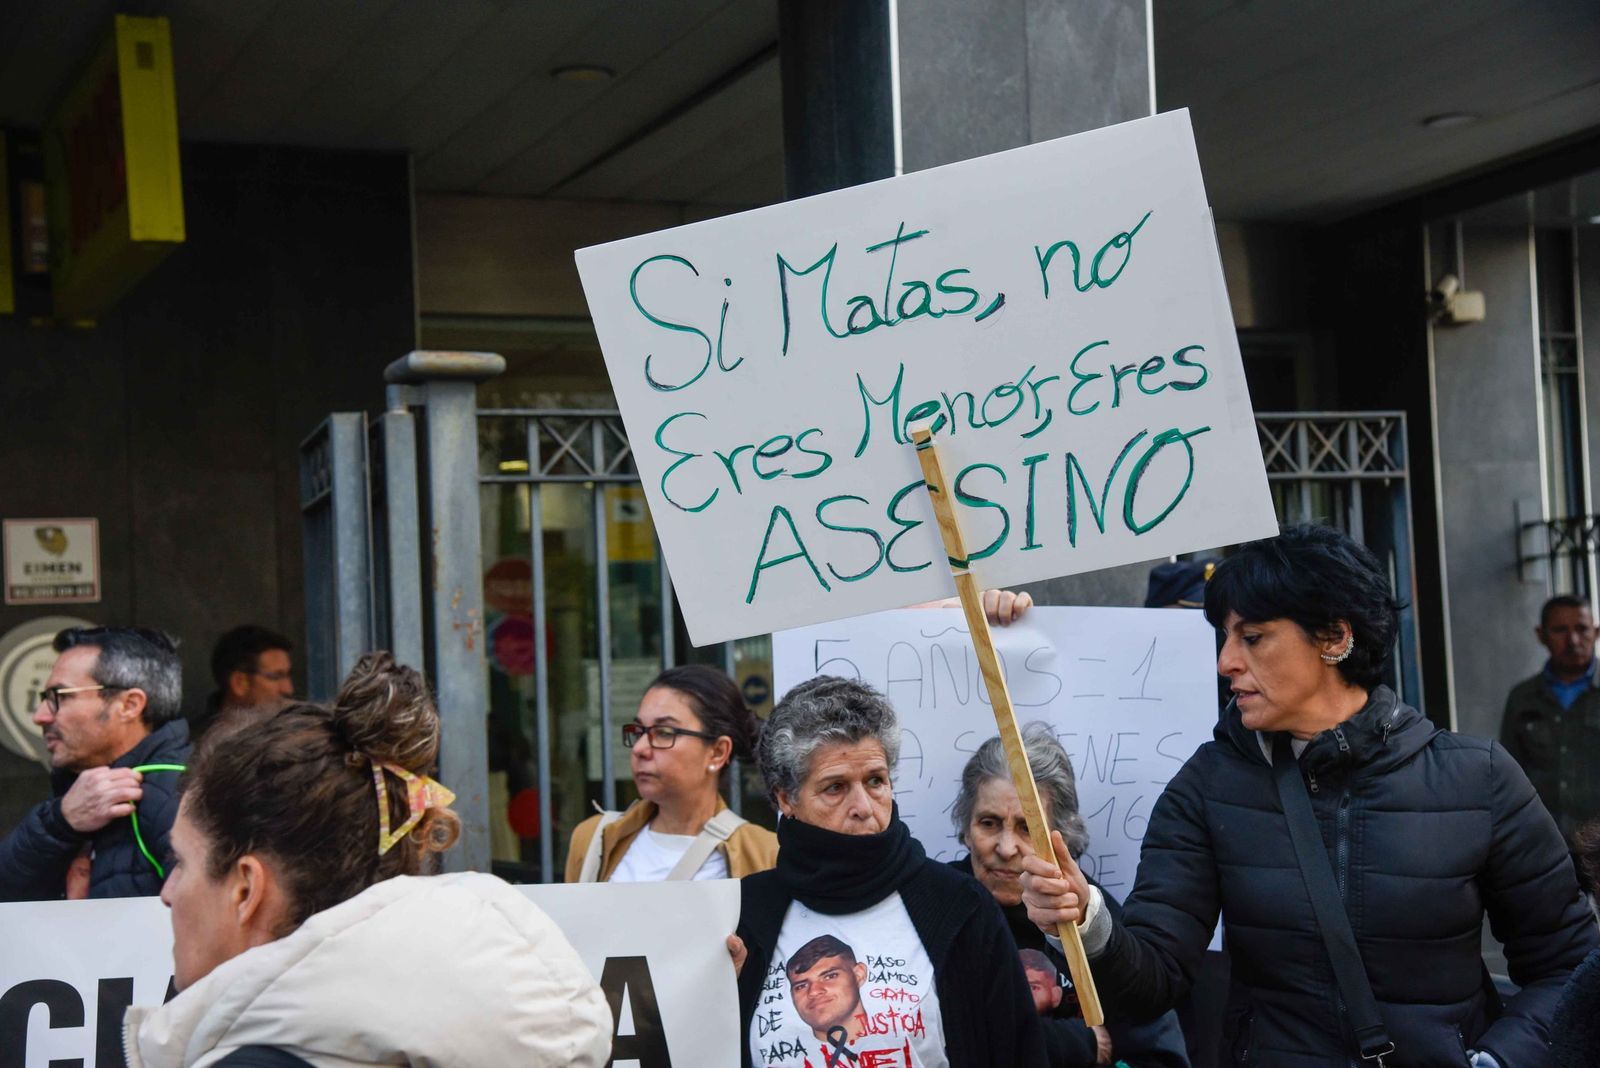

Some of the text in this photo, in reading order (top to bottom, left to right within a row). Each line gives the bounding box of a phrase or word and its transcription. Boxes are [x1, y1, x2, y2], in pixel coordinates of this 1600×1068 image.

[630, 210, 1153, 393] Si Matas, no
[654, 412, 833, 513] Eres
[745, 426, 1212, 604] ASESINO
[866, 954, 907, 969] PASO
[868, 970, 919, 987] DAMOS
[760, 1035, 808, 1065] PARA
